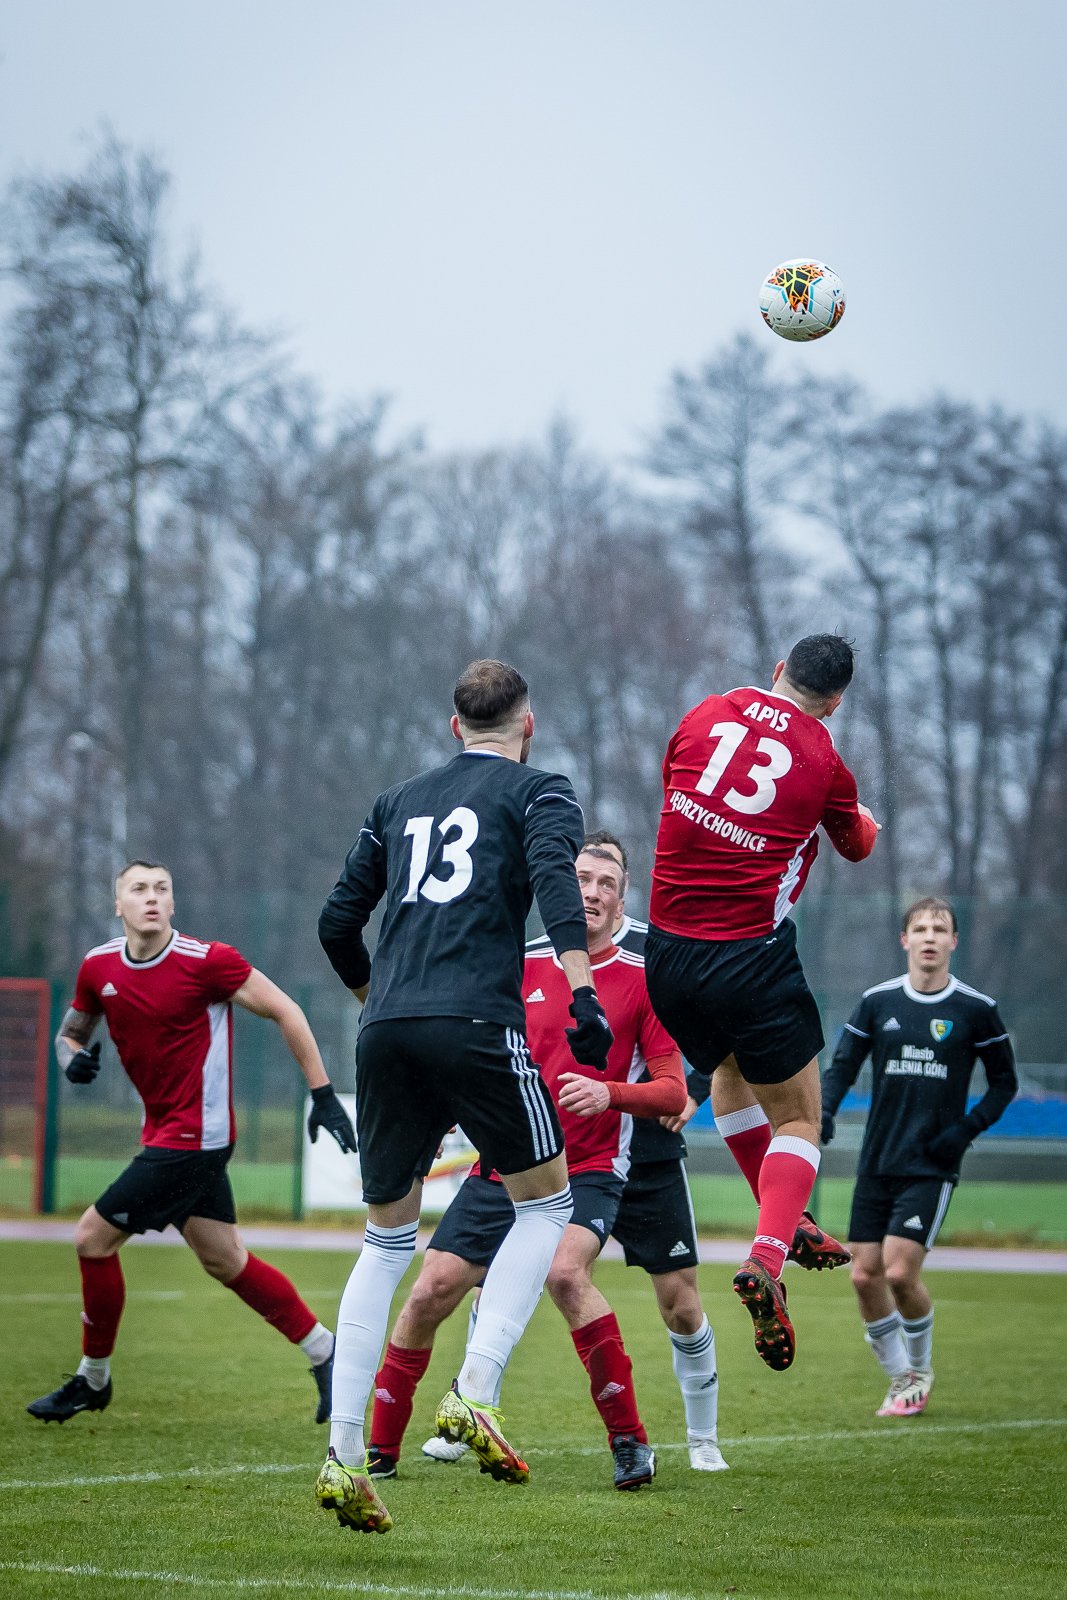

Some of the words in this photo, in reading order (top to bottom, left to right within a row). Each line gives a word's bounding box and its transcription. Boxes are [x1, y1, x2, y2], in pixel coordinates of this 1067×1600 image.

[742, 701, 792, 732] APIS
[694, 721, 793, 815] 13
[400, 806, 480, 904] 13
[885, 1059, 923, 1076] JELENIA
[901, 1044, 935, 1062] Miasto
